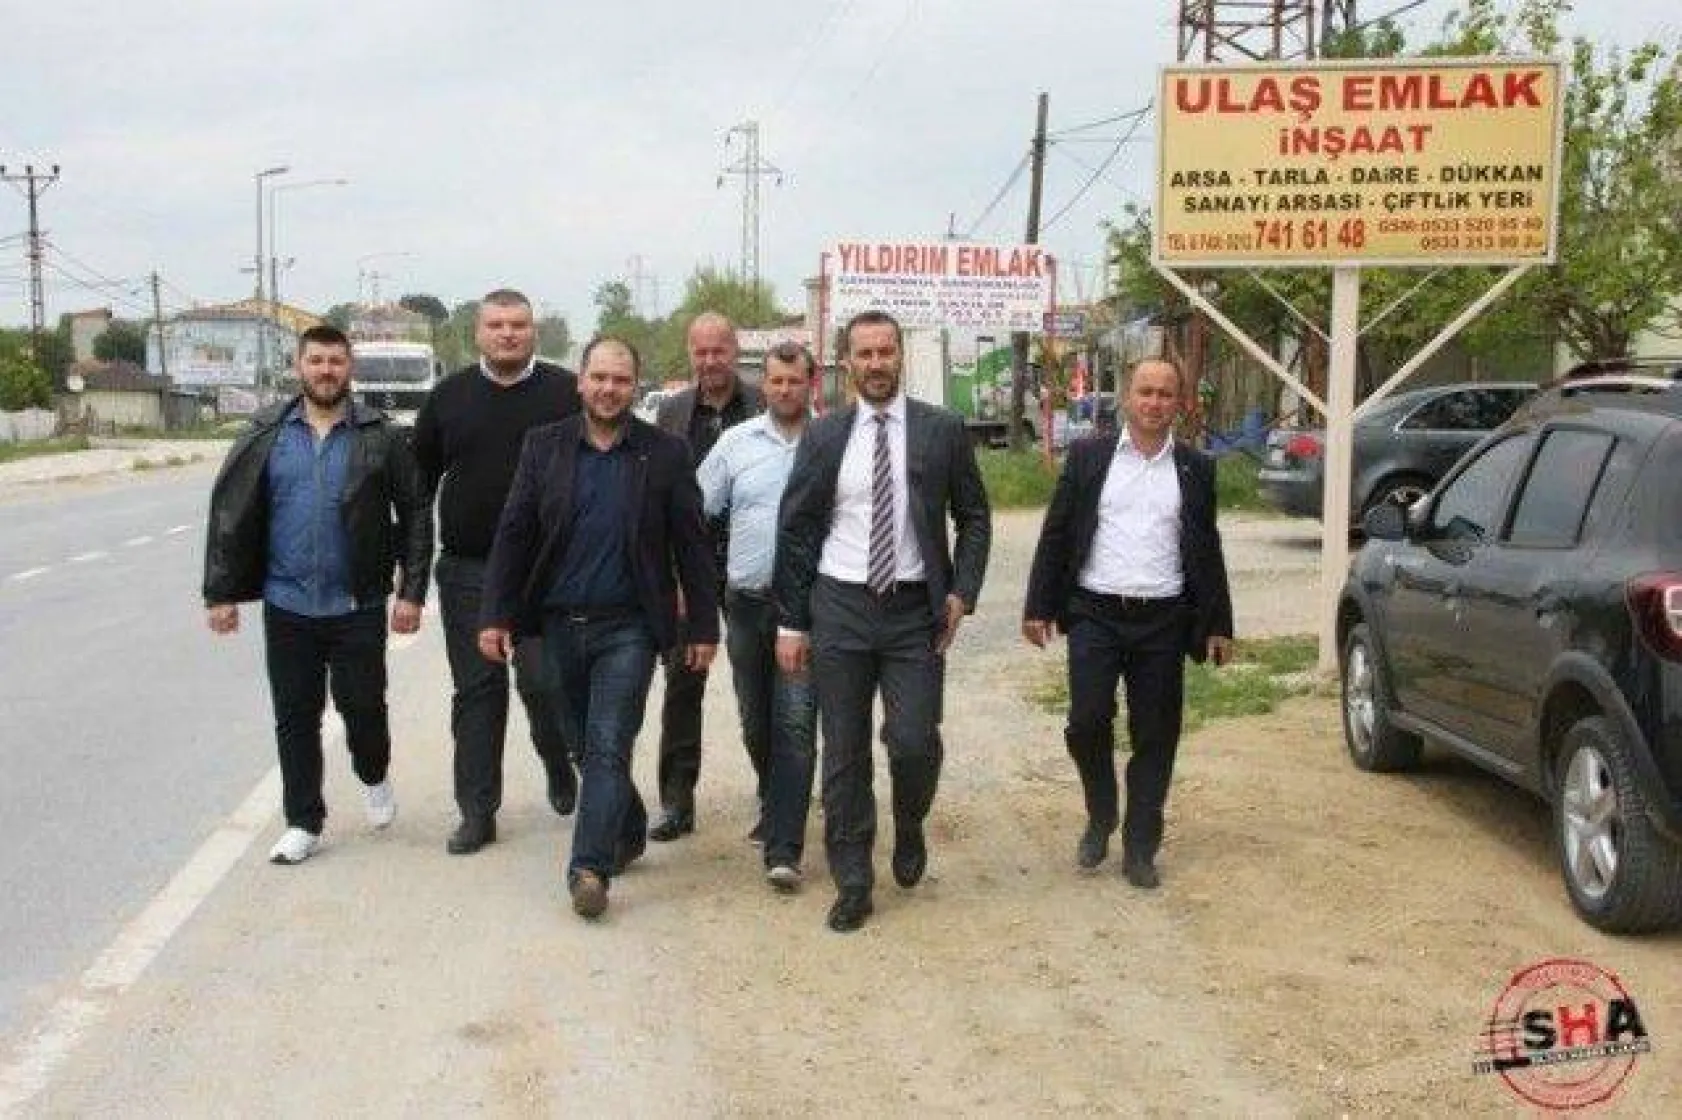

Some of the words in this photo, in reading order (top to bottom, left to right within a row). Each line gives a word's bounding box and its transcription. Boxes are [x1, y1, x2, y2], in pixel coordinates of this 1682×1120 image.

[1176, 76, 1321, 123] ULAŞ
[1342, 71, 1543, 112] EMLAK
[1170, 169, 1232, 188] ARSA
[1254, 169, 1330, 186] TARLA
[1440, 162, 1544, 184] DÜKKAN
[1277, 193, 1361, 212] ARSASI
[1254, 220, 1293, 248] 741
[1302, 219, 1328, 248] 61
[1338, 219, 1366, 248] 48
[838, 243, 949, 274] YILDIRIM
[956, 246, 1043, 277] EMLAK
